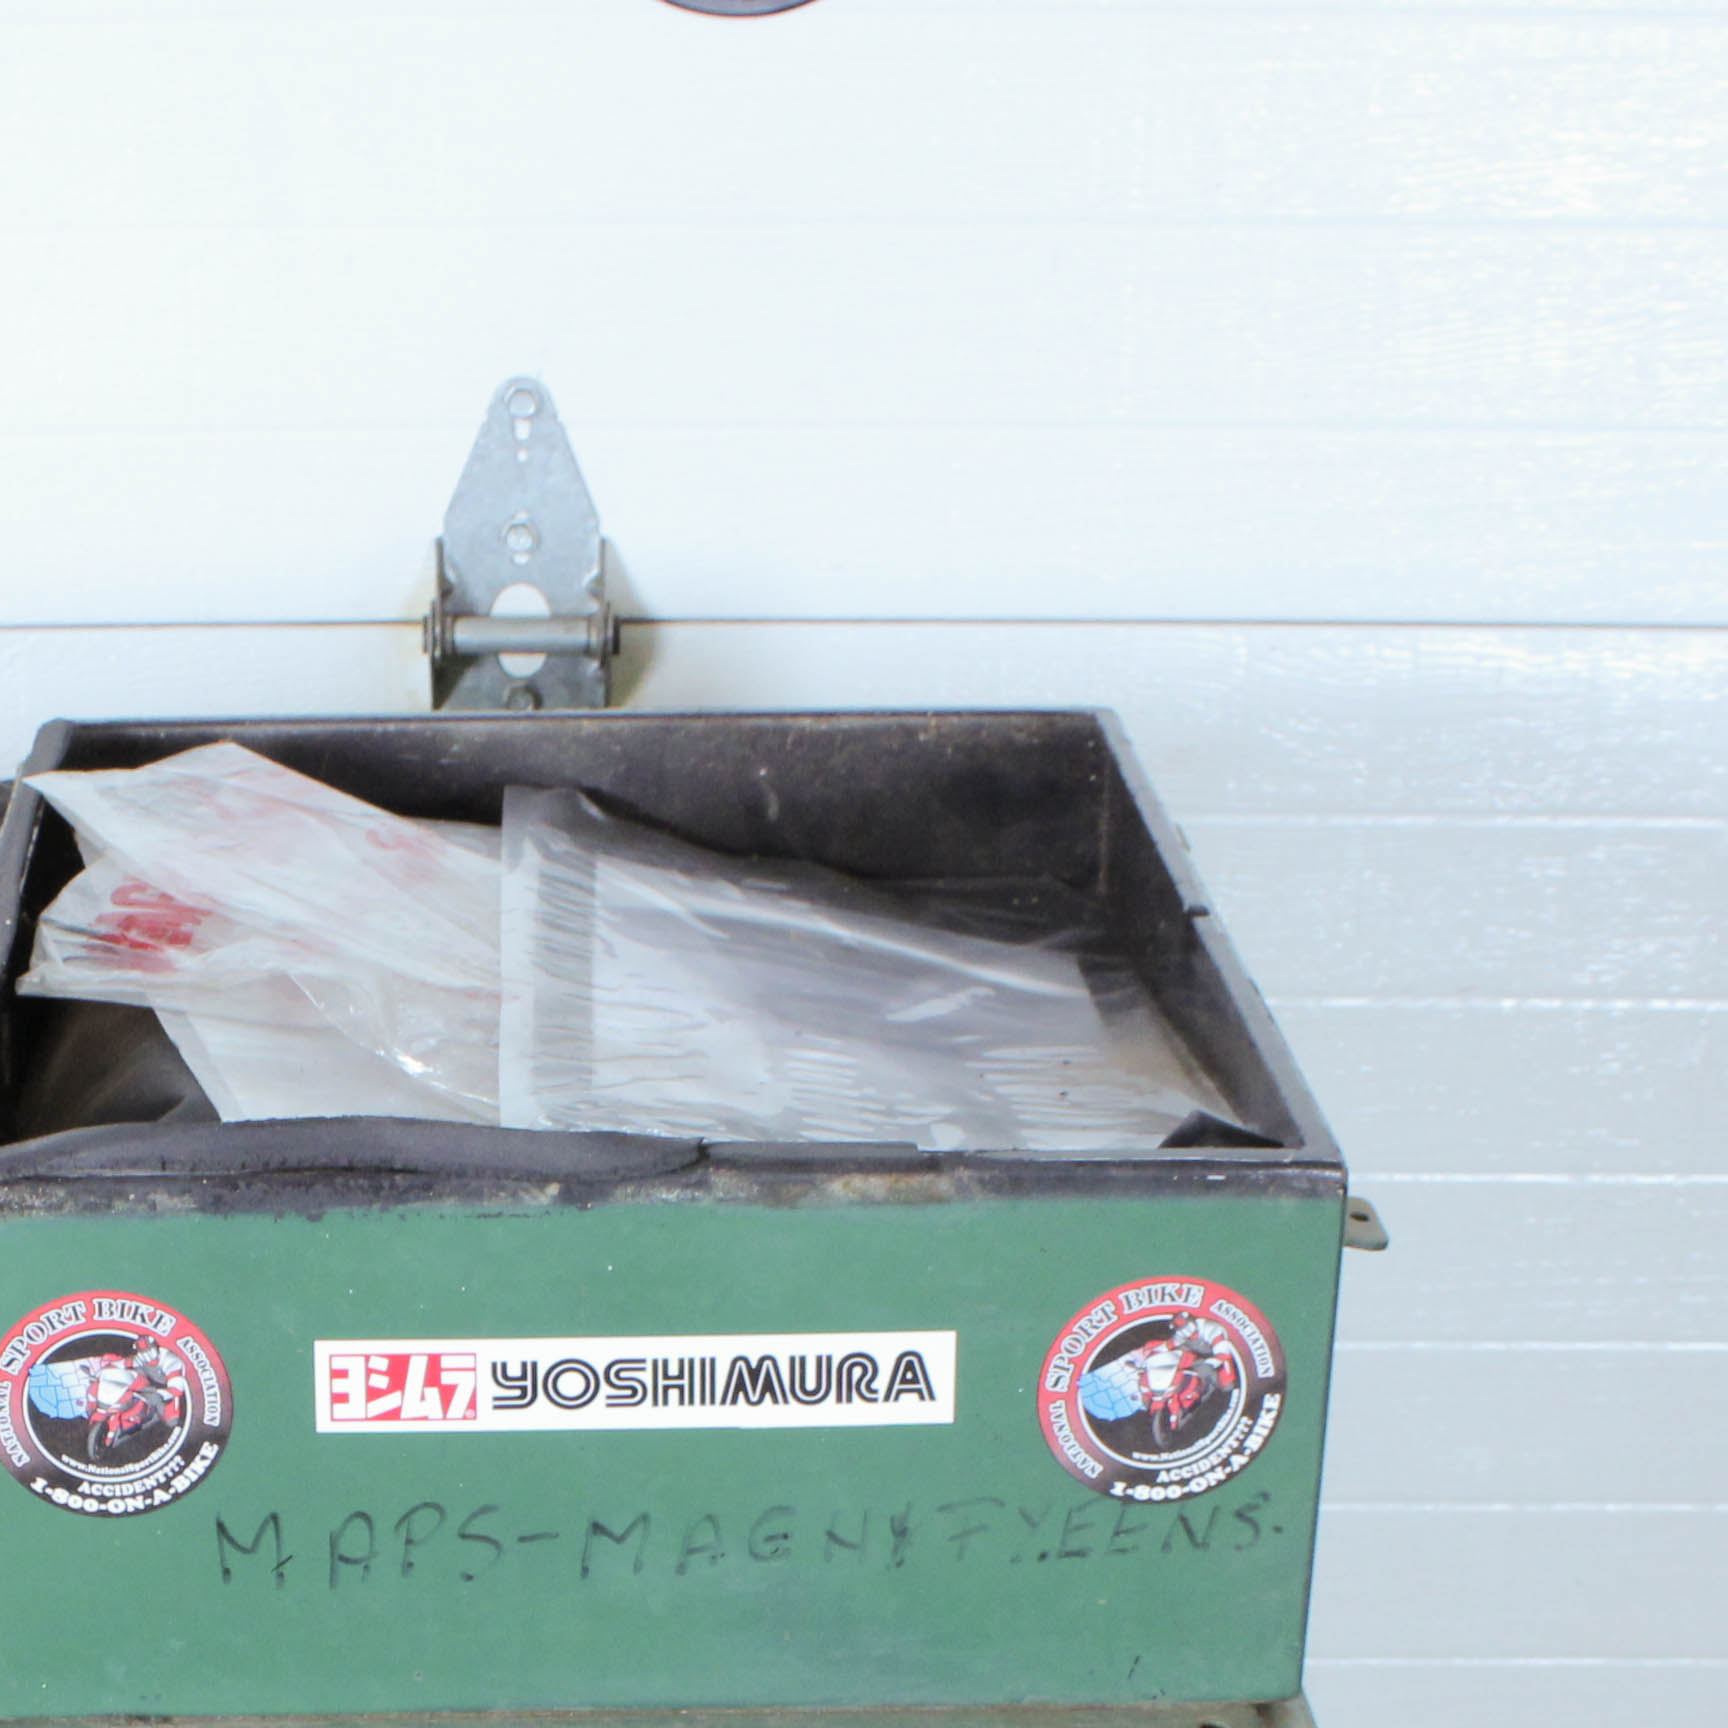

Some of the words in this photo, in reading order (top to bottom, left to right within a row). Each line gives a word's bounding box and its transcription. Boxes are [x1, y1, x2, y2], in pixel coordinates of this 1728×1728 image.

[1117, 1282, 1205, 1315] BIKE
[1209, 1298, 1276, 1379] ASSOCIATION
[92, 1298, 177, 1337] BIKE
[177, 1336, 221, 1427] ASSOCIATION
[492, 1350, 937, 1411] YOSHIMURA
[1044, 1300, 1118, 1392] SPORT
[1048, 1399, 1104, 1479] NATIONAL
